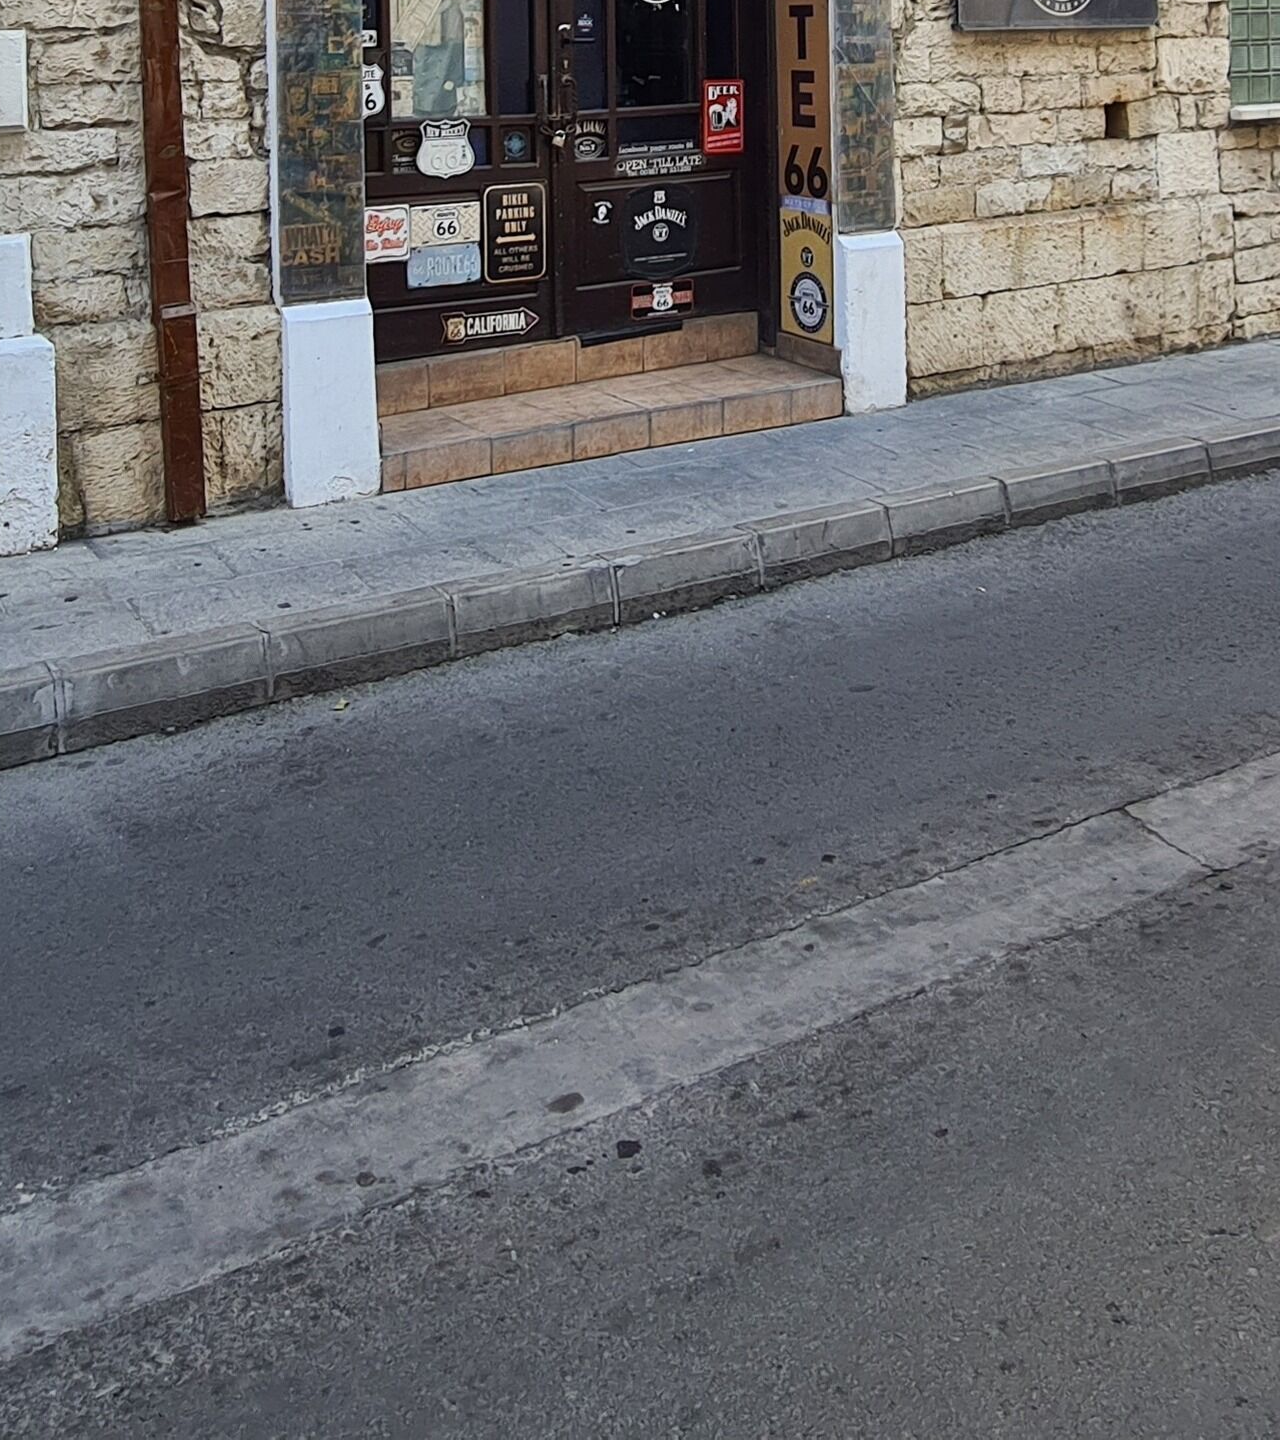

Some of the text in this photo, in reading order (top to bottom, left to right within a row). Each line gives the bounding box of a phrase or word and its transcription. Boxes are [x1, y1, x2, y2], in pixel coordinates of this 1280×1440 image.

[1054, 2, 1073, 12] BAR
[708, 85, 740, 100] BEER
[616, 159, 647, 171] OPEN
[675, 154, 702, 166] LATE
[784, 144, 828, 198] 66
[502, 193, 528, 206] BIKER
[495, 206, 535, 220] PARKING
[633, 209, 656, 230] JACK
[654, 205, 688, 229] DANIEL'S
[436, 220, 457, 236] 66
[504, 220, 528, 233] ONLY
[493, 244, 539, 255] ALL OTHERS
[501, 255, 519, 263] WILL
[498, 263, 535, 273] CRUSHED
[802, 300, 815, 315] 66
[466, 311, 527, 336] CALIFORNIA
